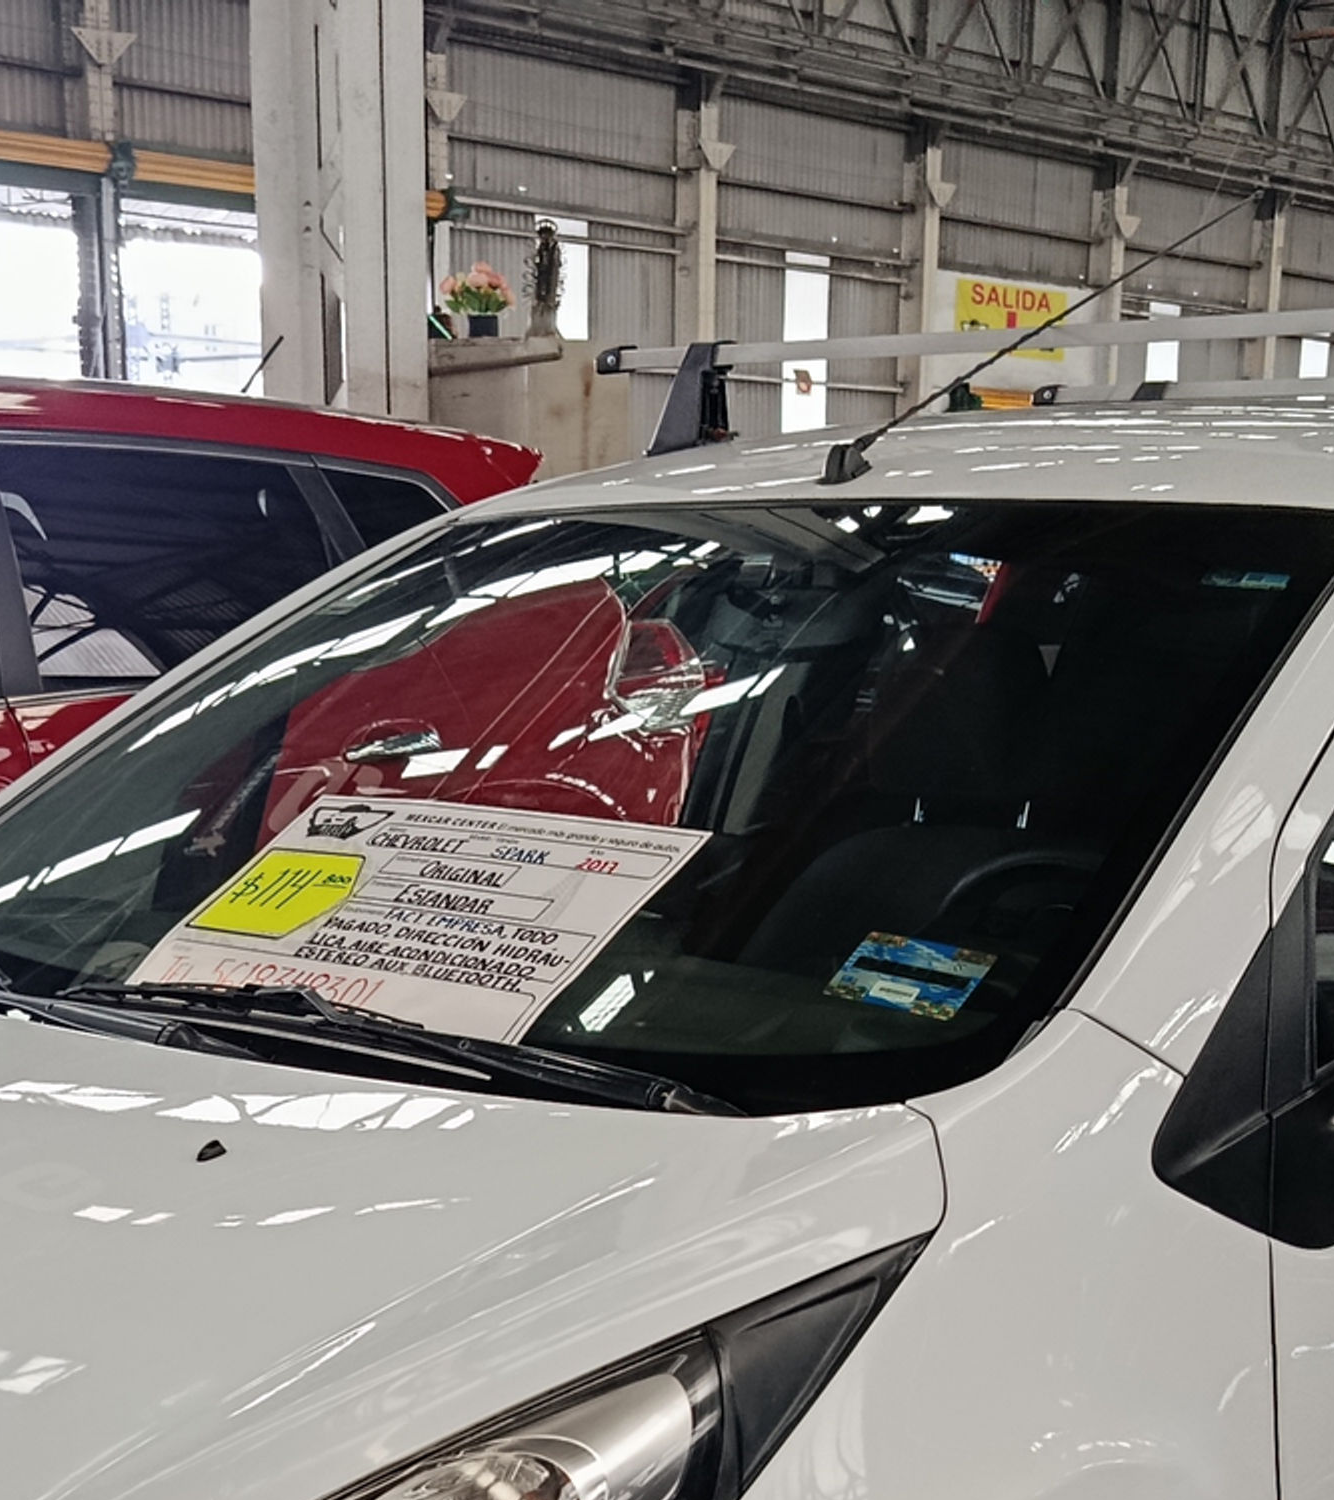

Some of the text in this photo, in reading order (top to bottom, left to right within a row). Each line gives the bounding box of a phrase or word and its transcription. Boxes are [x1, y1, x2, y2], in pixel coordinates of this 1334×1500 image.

[971, 284, 1051, 312] SALIDA
[451, 817, 498, 830] CENTER
[370, 832, 470, 853] CHEVROLET
[490, 844, 550, 865] SPARK
[575, 857, 619, 874] 2017
[418, 860, 505, 888] ORIGINAL
[393, 884, 495, 914] ESTANDAR
[323, 916, 392, 938] PAGADO,
[394, 926, 492, 951] DIRECCIÓN
[347, 940, 390, 954] AIRE
[511, 927, 559, 945] TODO
[293, 946, 370, 967] ESTEREO
